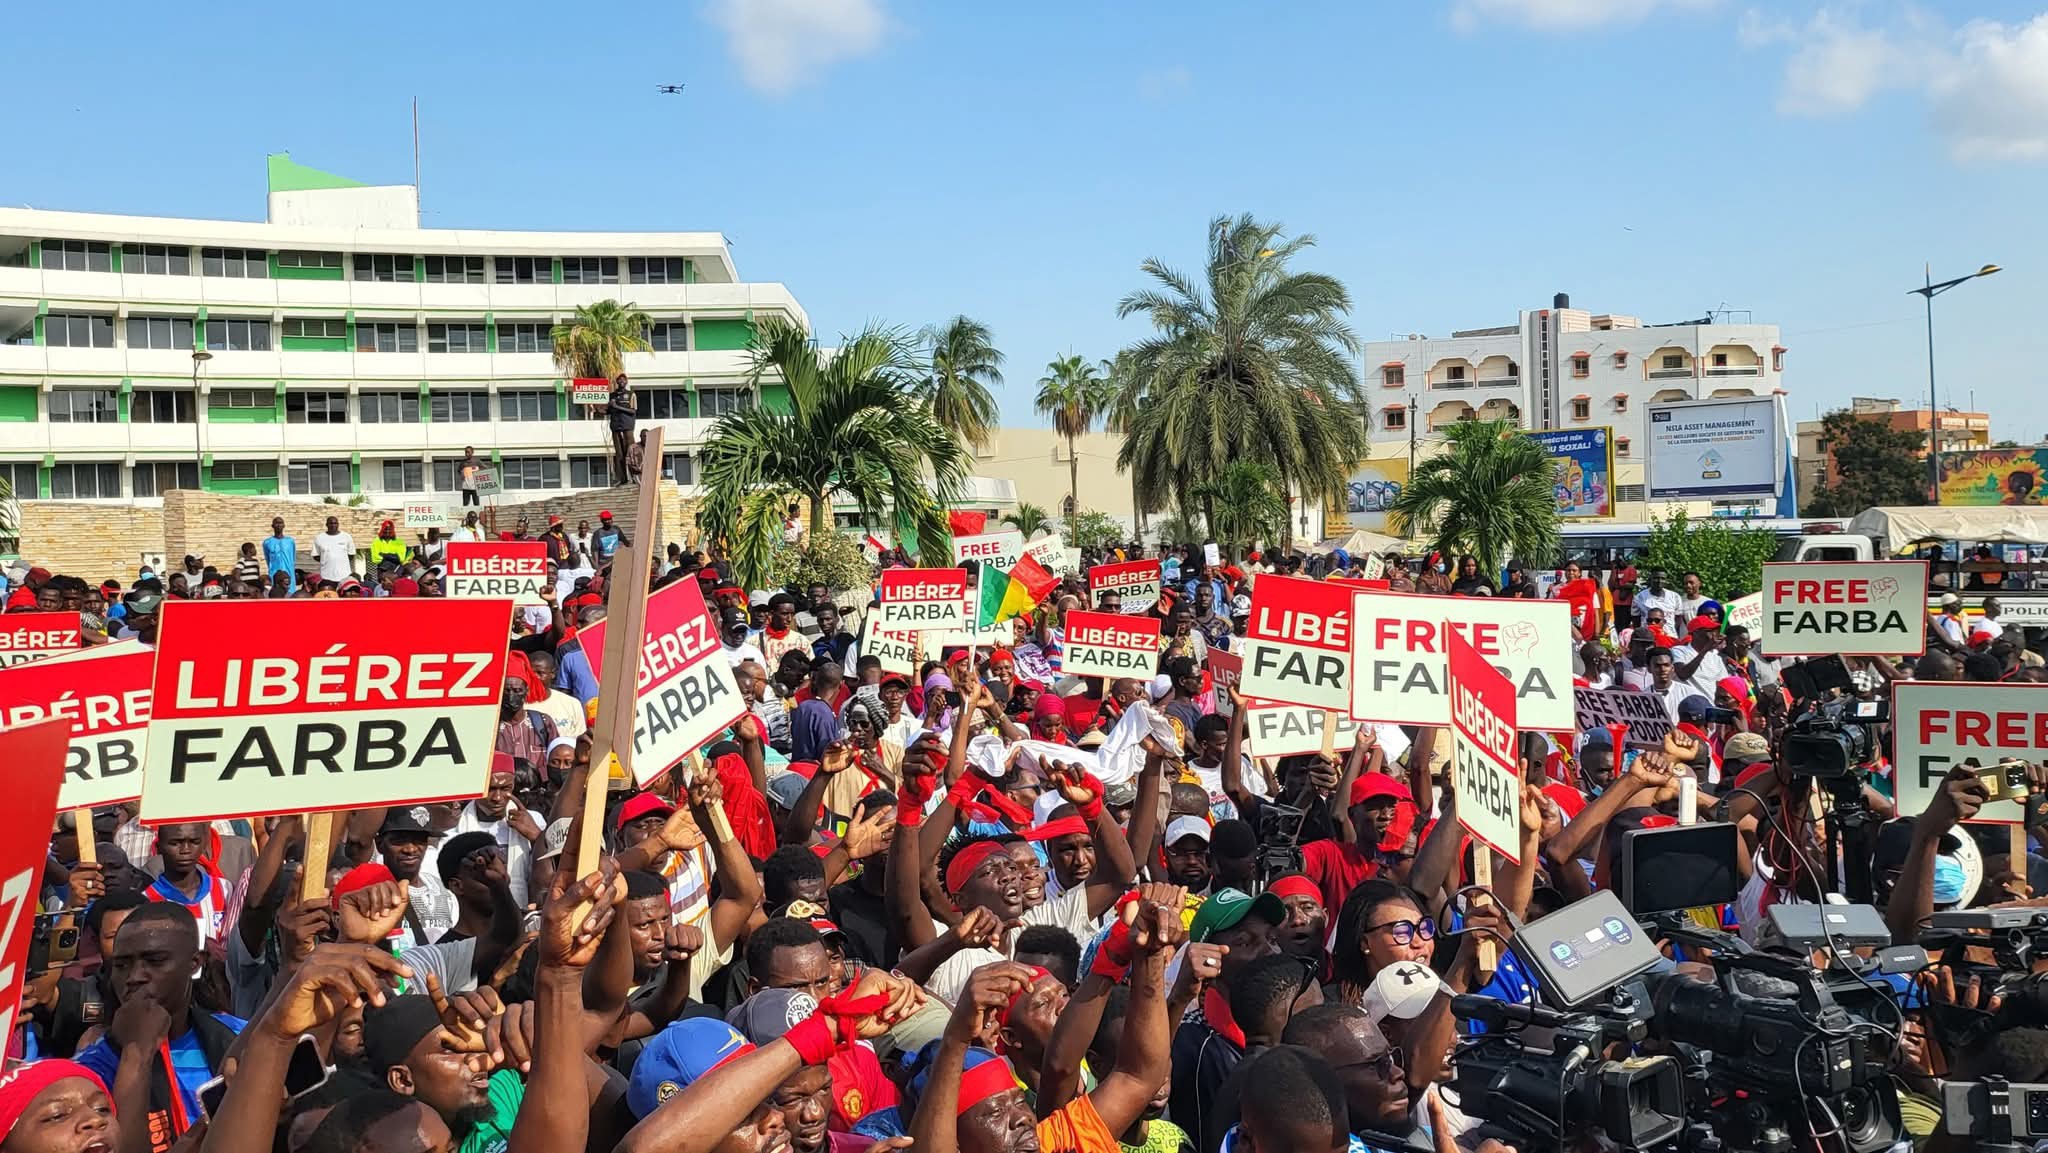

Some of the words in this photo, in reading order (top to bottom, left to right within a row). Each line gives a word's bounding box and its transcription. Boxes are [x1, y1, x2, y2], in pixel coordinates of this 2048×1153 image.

[575, 384, 608, 392] LIBÉREZ
[575, 392, 606, 400] FARBA
[1665, 424, 1682, 433] NSIA
[1684, 423, 1703, 431] ASSET
[1704, 420, 1756, 429] MANAGEMENT
[1559, 441, 1591, 452] SOXALI
[408, 506, 433, 514] FREE
[408, 514, 444, 523] FARBA
[960, 541, 1000, 557] FREE
[1026, 544, 1049, 557] REE
[452, 555, 543, 574] LIBÉREZ
[974, 555, 1018, 569] RBA
[453, 578, 540, 595] FARBA
[1094, 569, 1158, 588] LIBÉREZ
[885, 581, 961, 600] LIBÉREZ
[1096, 583, 1155, 601] FRBA
[1774, 579, 1869, 605] FREE
[885, 603, 957, 622] FARBA
[1732, 602, 1761, 622] FREE
[1258, 607, 1349, 647] LIBÉ
[1773, 610, 1908, 634] FARBA
[1070, 626, 1157, 650] LIBÉREZ
[1069, 647, 1149, 670] FARBA
[175, 643, 494, 709] LIBÉREZ
[1373, 660, 1557, 700] FAA
[1613, 694, 1668, 720] FARBA
[1452, 675, 1517, 769] LIBÉREZ
[169, 717, 467, 784] FARBA
[1457, 738, 1514, 828] FARBA
